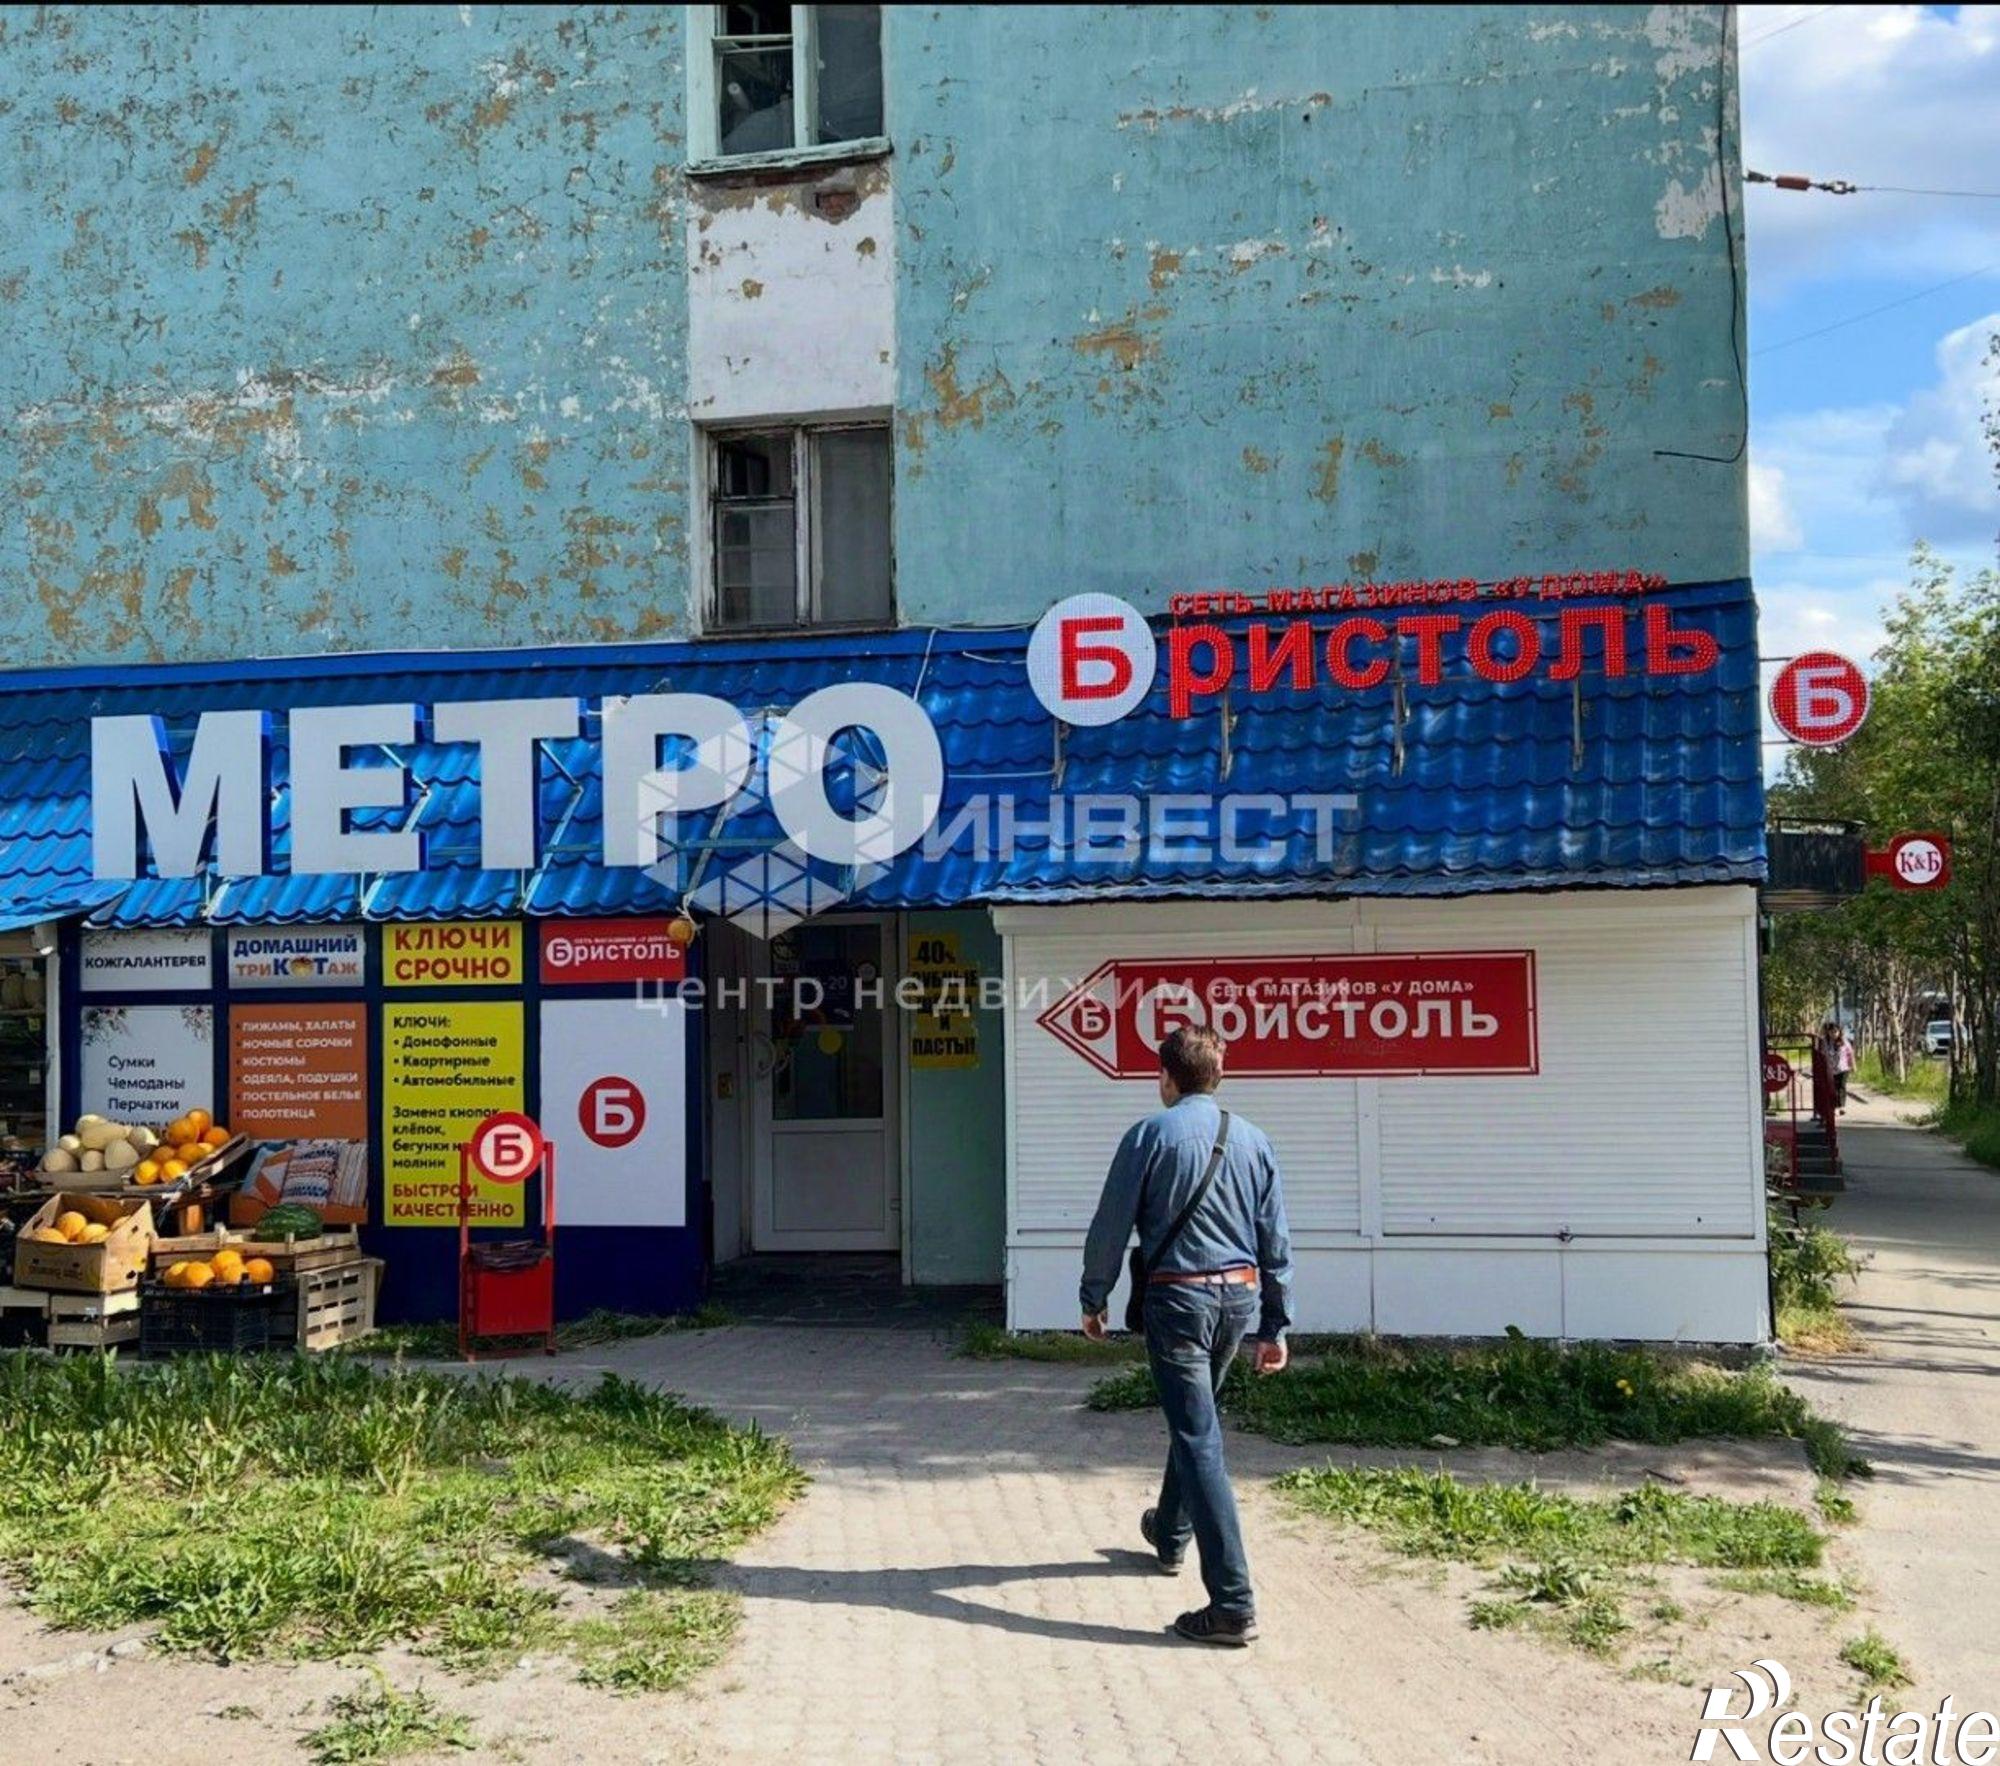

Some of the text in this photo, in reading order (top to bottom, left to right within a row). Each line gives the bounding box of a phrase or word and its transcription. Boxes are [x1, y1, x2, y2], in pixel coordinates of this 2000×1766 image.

[1169, 591, 1254, 615] СЕТЬ
[1267, 572, 1478, 611] МАГАЗИНОВ
[1059, 604, 1718, 719] Бристоль
[1795, 666, 1853, 728] Б
[92, 681, 944, 881] МЕТРО
[233, 933, 358, 957] ДОМАШНИЙ
[394, 926, 510, 951] КЛЮЧИ
[549, 940, 680, 966] Бристоль
[85, 955, 206, 970] КОЖГАЛАНТЕРЕЯ
[394, 957, 511, 981] СРОЧНО
[1210, 983, 1258, 998] СЕТЬ
[1263, 981, 1377, 997] МАГАЗИНОВ
[1408, 979, 1474, 996] ДОМА»
[393, 1015, 451, 1028] КЛЮЧИ:
[1081, 1008, 1104, 1033] Б
[296, 1038, 353, 1048] СОРОЧКИ
[402, 1035, 498, 1049] Домофонные
[107, 1055, 155, 1071] Сумки
[402, 1055, 491, 1069] Квартирные
[107, 1076, 186, 1090] Чемоданы
[297, 1072, 358, 1084] ПОДУШКИ
[402, 1073, 516, 1087] Автомобильные
[242, 1091, 320, 1101] ПОСТЕЛЬНОЕ
[108, 1098, 180, 1113] Перчатки
[242, 1108, 317, 1119] ПОЛОТЕНЦА
[393, 1105, 447, 1119] Замена
[594, 1088, 636, 1136] Б
[393, 1123, 447, 1136] клёпок,
[393, 1138, 449, 1155] бегунки
[493, 1132, 525, 1168] Б
[393, 1159, 447, 1169] молнии
[393, 1202, 515, 1218] КАЧЕСТЕННО
